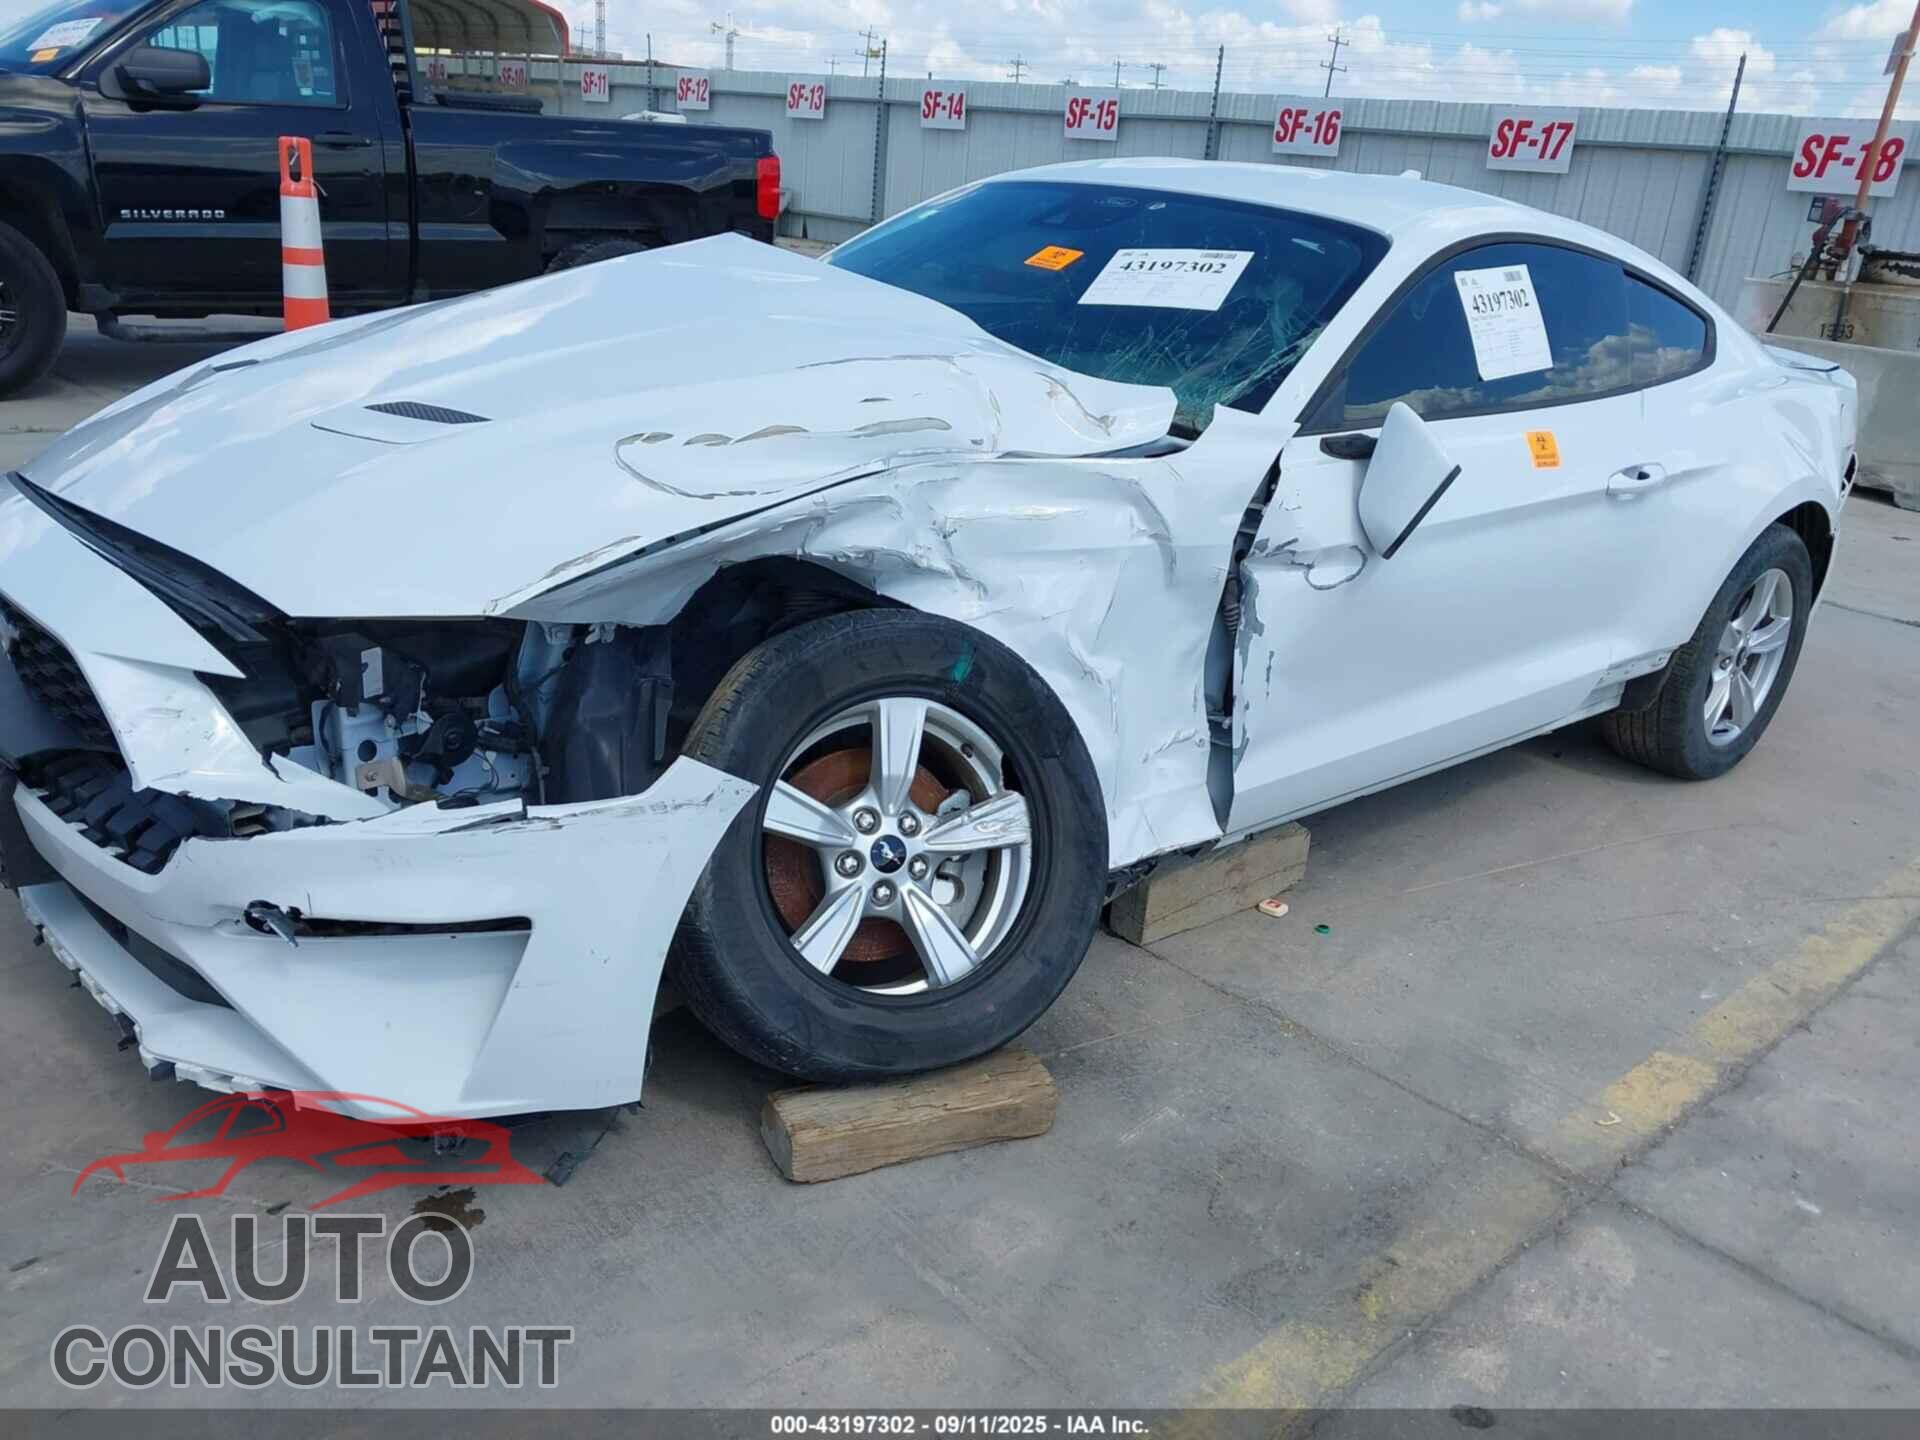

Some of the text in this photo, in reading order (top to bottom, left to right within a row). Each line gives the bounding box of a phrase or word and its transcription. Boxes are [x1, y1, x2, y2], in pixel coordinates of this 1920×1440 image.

[583, 71, 607, 95] SF-11
[678, 78, 708, 103] SF-12
[788, 83, 825, 111] SF-13
[922, 91, 965, 121] SF-14
[1065, 97, 1118, 131] SF-15
[1274, 108, 1342, 147] SF-16
[1491, 118, 1575, 161] SF-17
[1792, 133, 1905, 183] SF-18
[119, 208, 226, 219] SILVERADO
[1119, 260, 1227, 274] 43197302
[1472, 288, 1530, 314] 43197302
